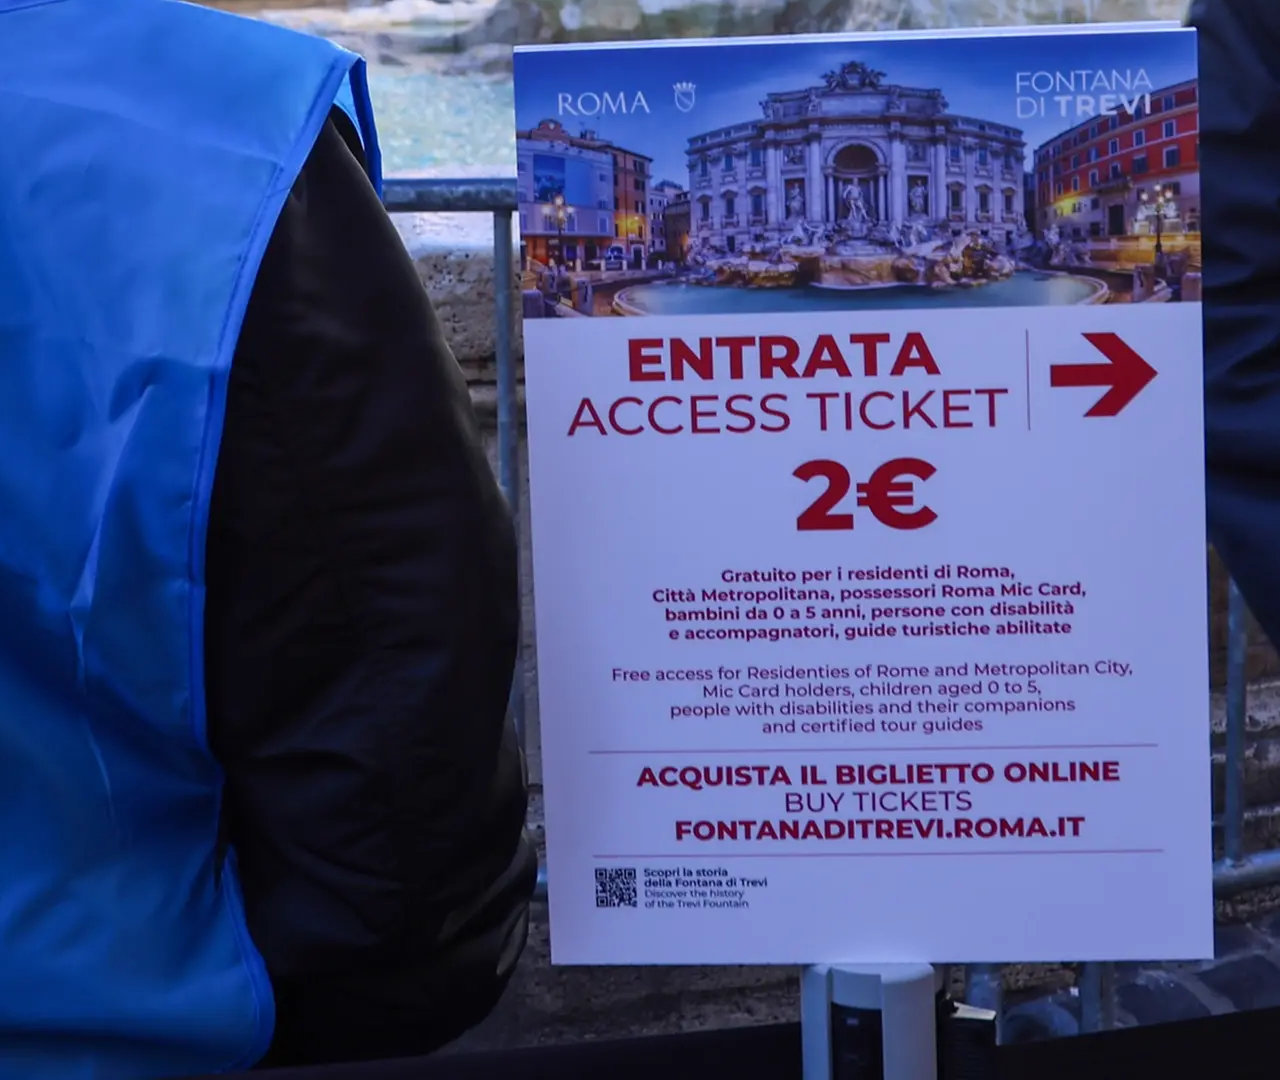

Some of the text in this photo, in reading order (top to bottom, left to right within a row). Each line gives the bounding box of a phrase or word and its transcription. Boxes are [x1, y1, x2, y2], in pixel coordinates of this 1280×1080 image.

[1016, 68, 1153, 94] FONTANA
[558, 91, 650, 116] ROMA
[1017, 92, 1152, 119] DI TREVI
[627, 331, 942, 383] ENTRATA
[566, 387, 1009, 437] ACCESS TICKET
[791, 456, 939, 532] 2€
[720, 563, 1016, 585] Gratuito per i residenti di Roma,
[652, 580, 1087, 605] Città Metropolitana, possessori Roma Mic Card,
[664, 599, 1075, 622] bambini da 0 a 5 anni, persone con disabilità
[668, 619, 1073, 643] e accompagnatori, guide turistiche abilitate
[612, 659, 1133, 682] Free access for Residenties of Rome and Metropolitan City,
[702, 679, 1042, 699] Mic Card holders, children aged 0 to 5,
[670, 696, 1076, 720] people with disabilities and their companions
[762, 716, 984, 736] and certified tour guides
[635, 760, 1121, 792] ACQUISTA IL BIGLIETTO ONLINE
[784, 789, 973, 814] BUY TICKETS
[674, 815, 1086, 842] FONTANADITREVI.ROMA.IT
